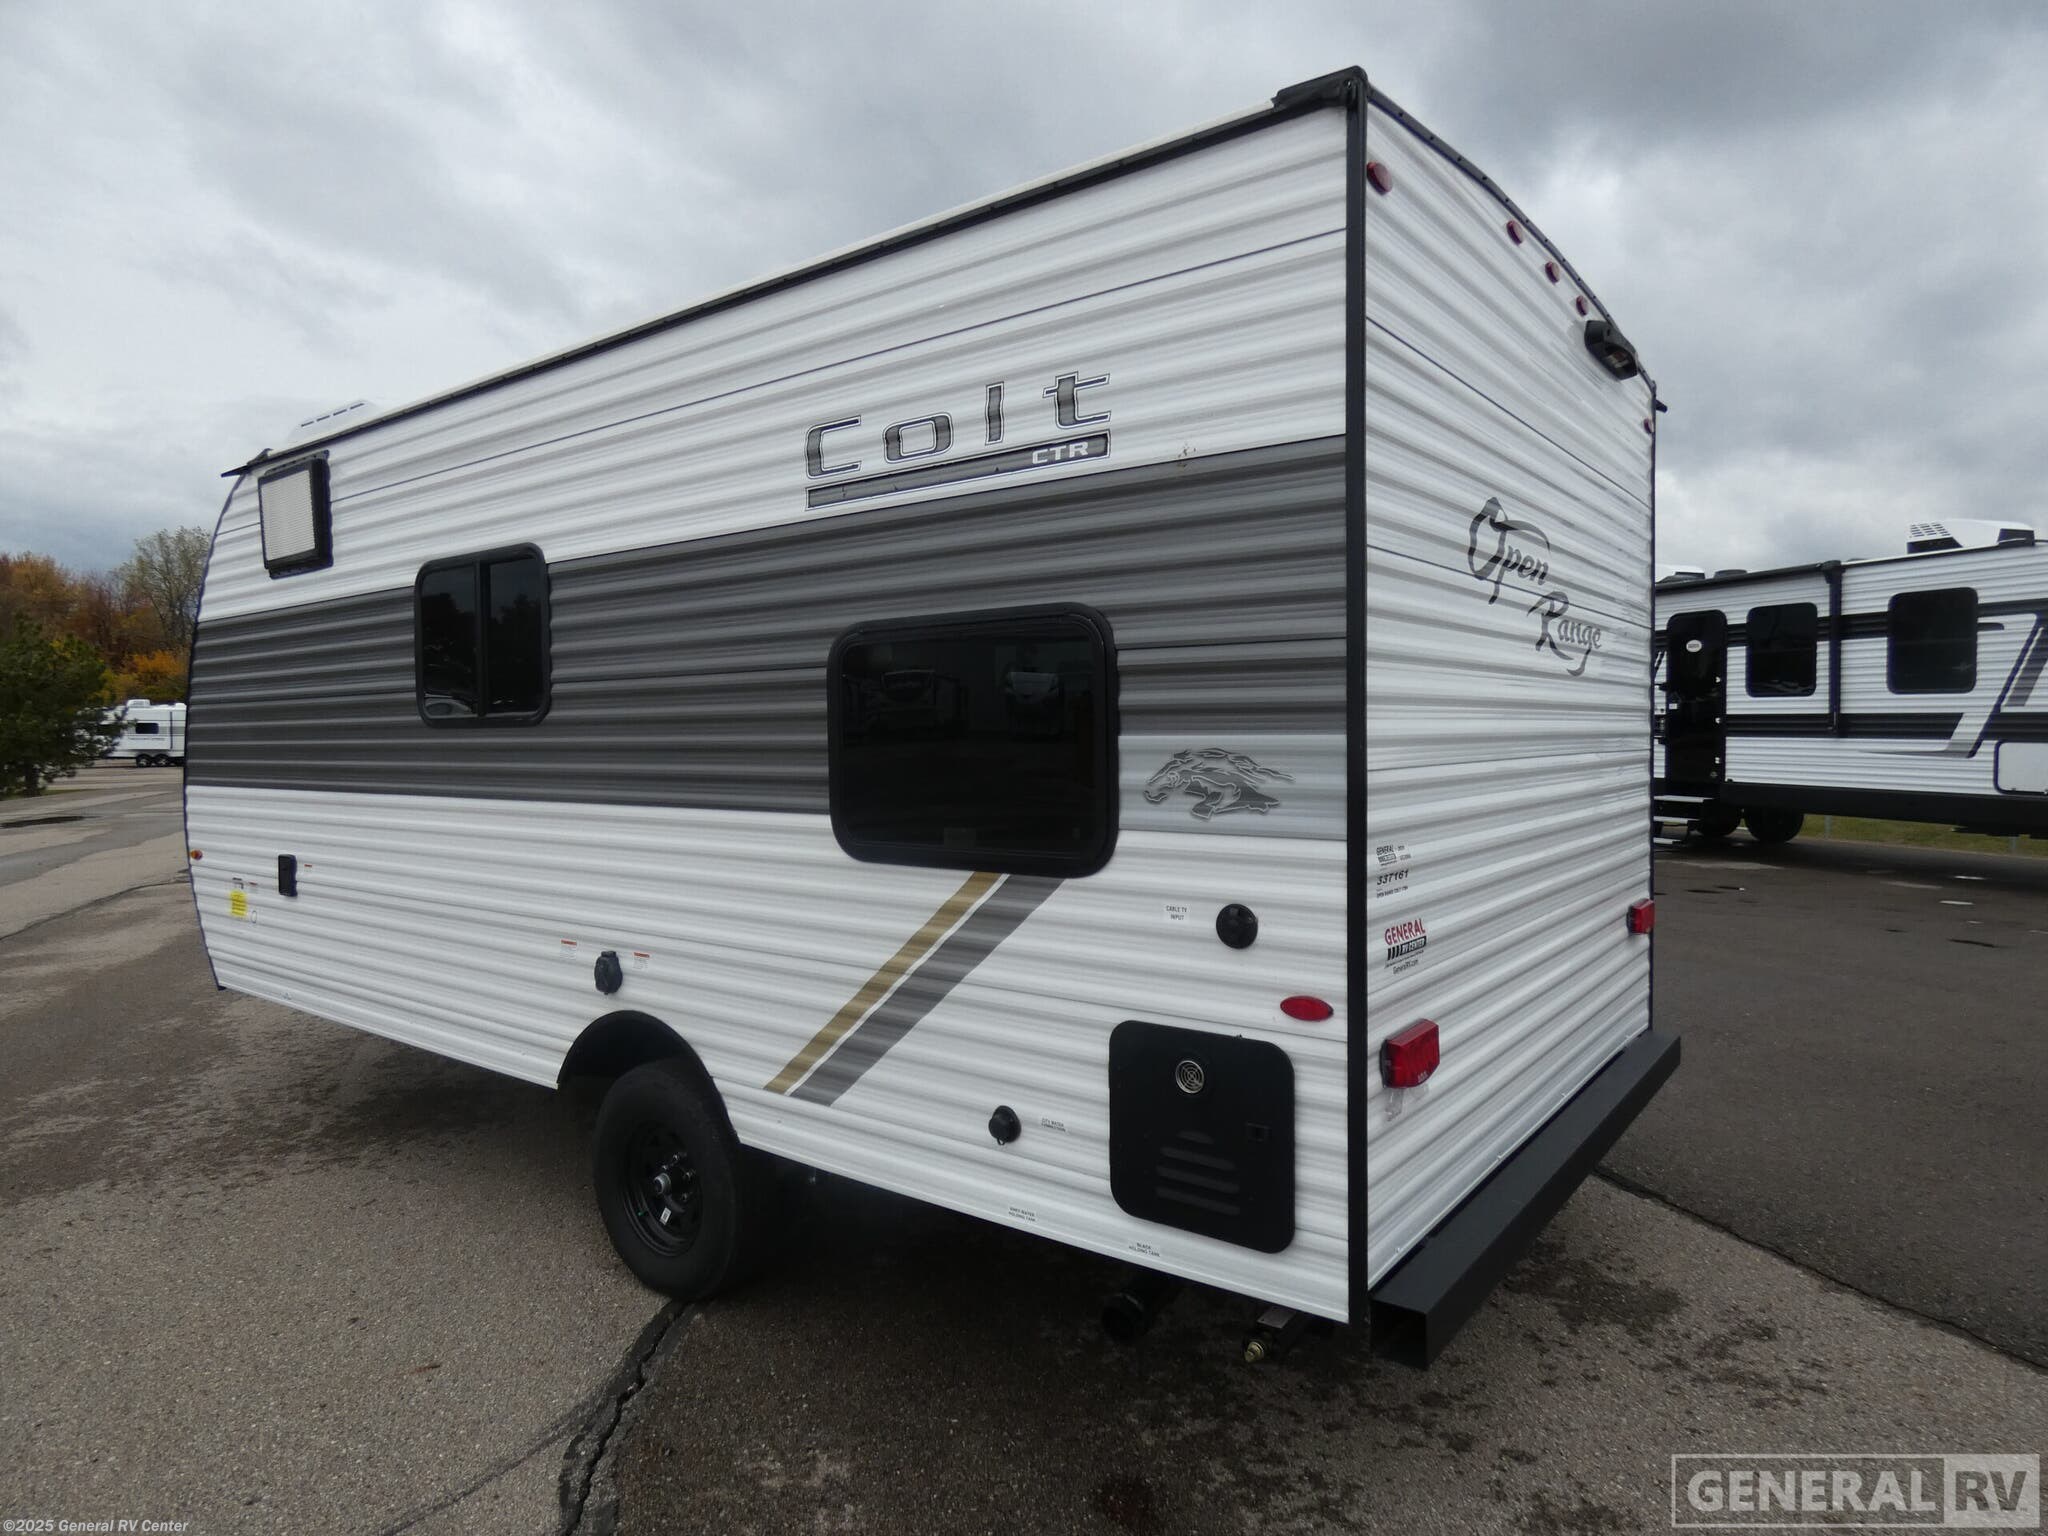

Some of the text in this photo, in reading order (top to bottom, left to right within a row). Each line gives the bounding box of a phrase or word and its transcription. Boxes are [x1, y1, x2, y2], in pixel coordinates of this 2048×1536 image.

[1032, 441, 1089, 464] CTR
[1468, 497, 1550, 605] Open
[1527, 591, 1602, 676] Range
[1377, 869, 1409, 886] 337161
[1384, 918, 1426, 946] GENERAL
